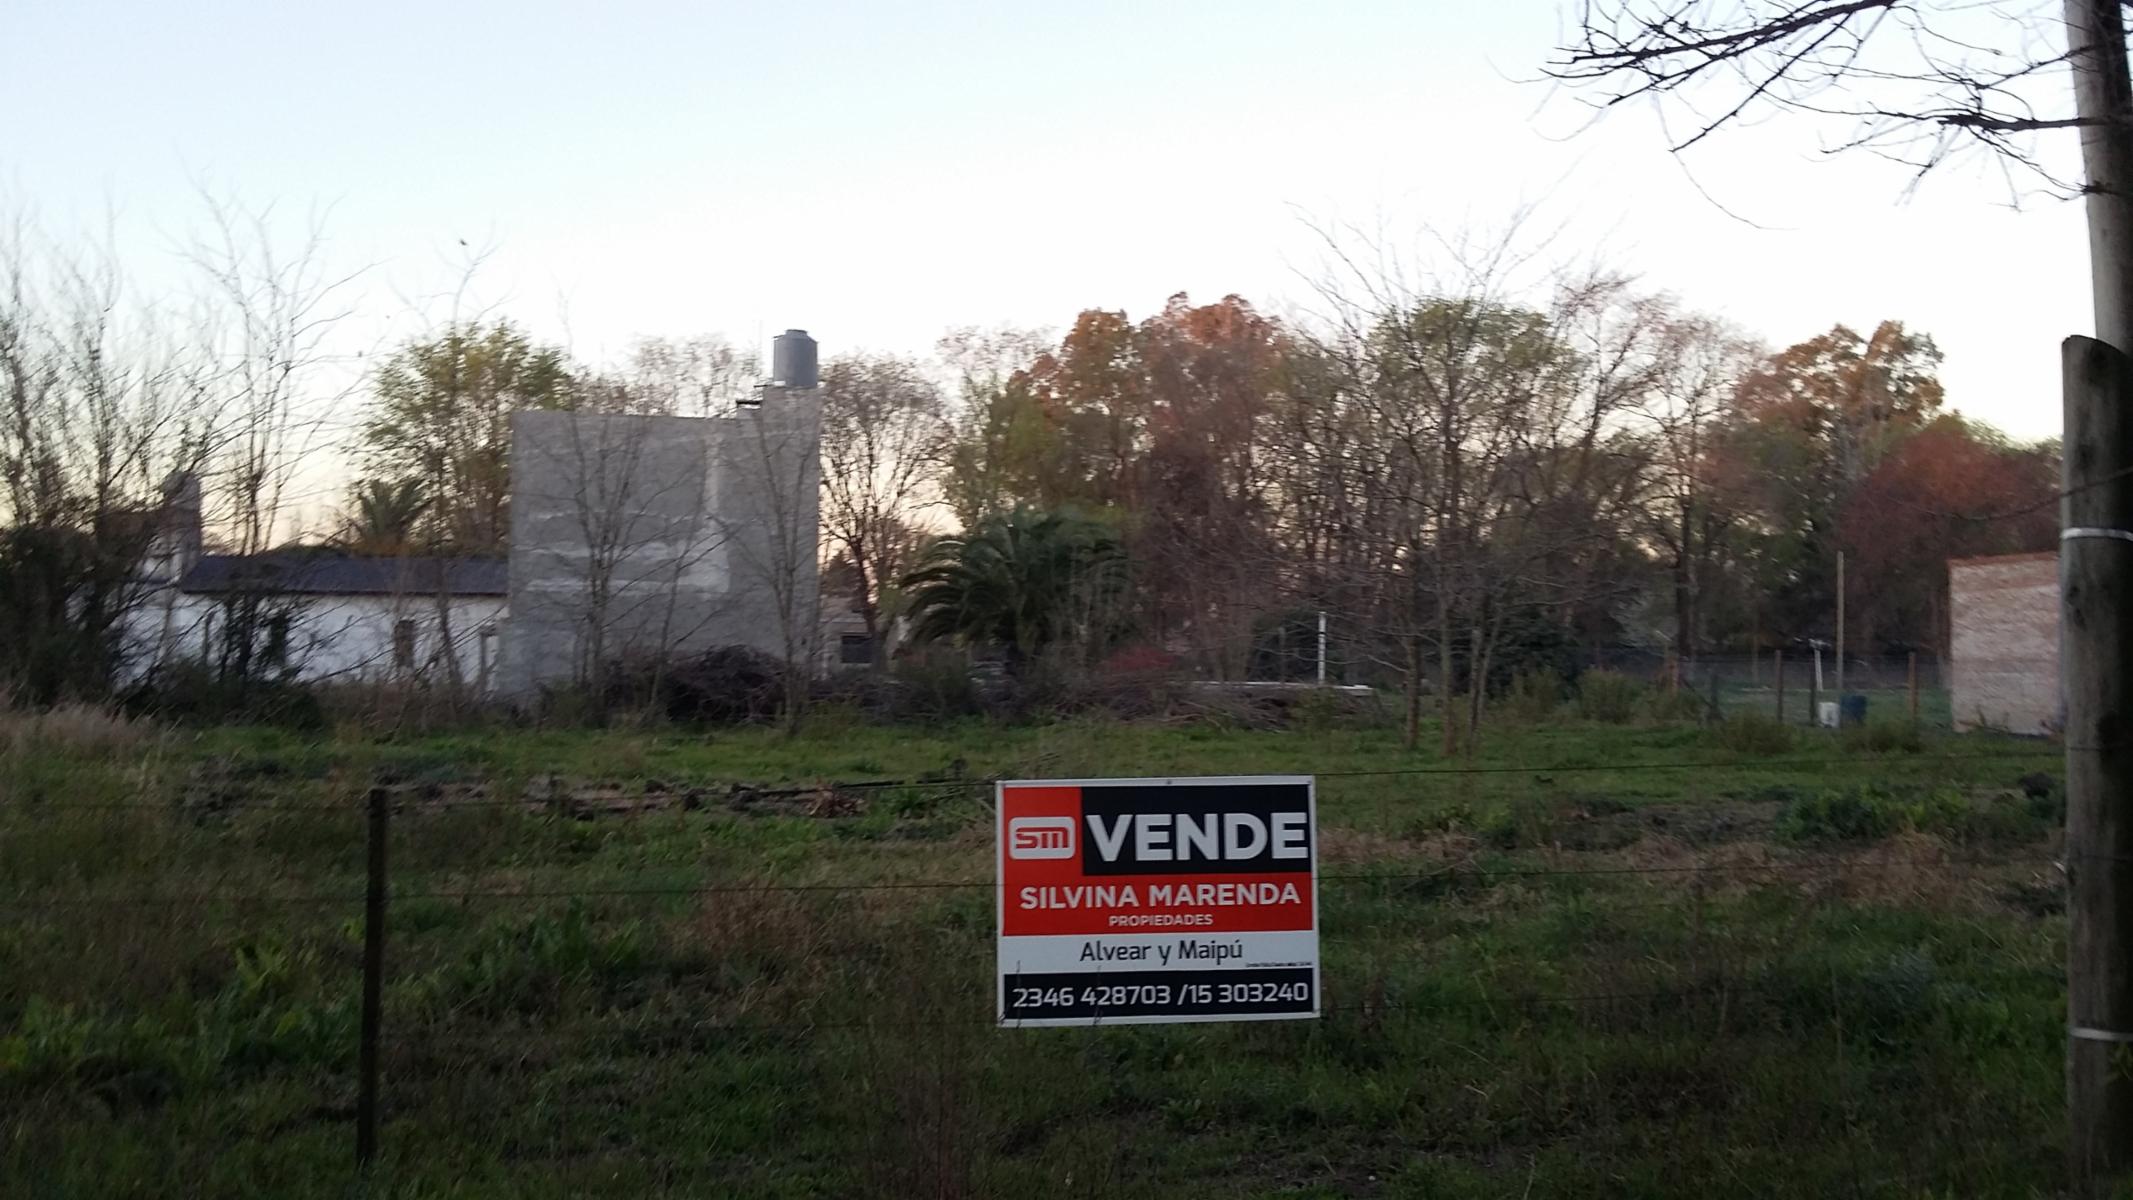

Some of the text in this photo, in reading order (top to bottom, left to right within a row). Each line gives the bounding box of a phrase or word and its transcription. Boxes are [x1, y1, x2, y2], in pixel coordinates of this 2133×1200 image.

[1085, 812, 1309, 861] VENDE
[1020, 882, 1301, 909] SILVINA MARENDA
[1108, 914, 1214, 927] PROPIEDADES
[1080, 939, 1243, 965] Alvear y Maipú
[1012, 983, 1309, 1008] 2346 428703 /15 303240
